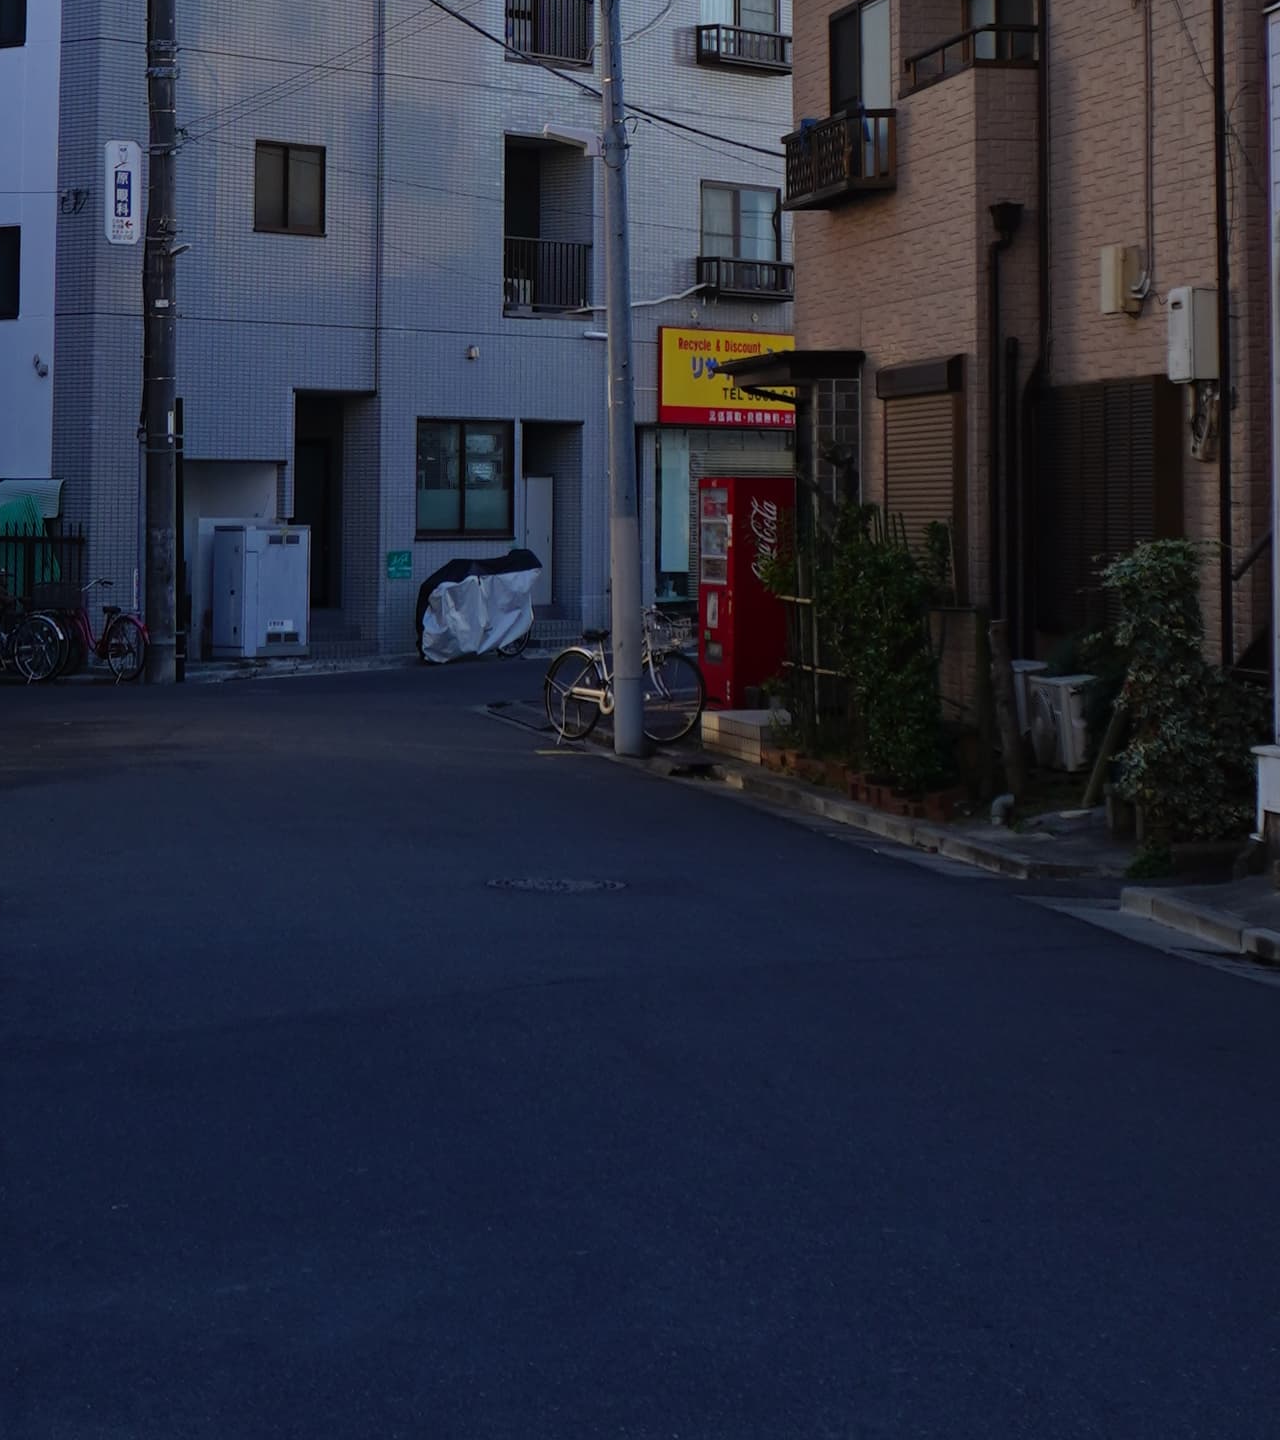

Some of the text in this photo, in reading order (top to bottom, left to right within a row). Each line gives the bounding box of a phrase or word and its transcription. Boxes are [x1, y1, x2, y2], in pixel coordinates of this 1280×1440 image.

[678, 337, 761, 353] Recycle & Discount
[722, 387, 744, 401] TEL
